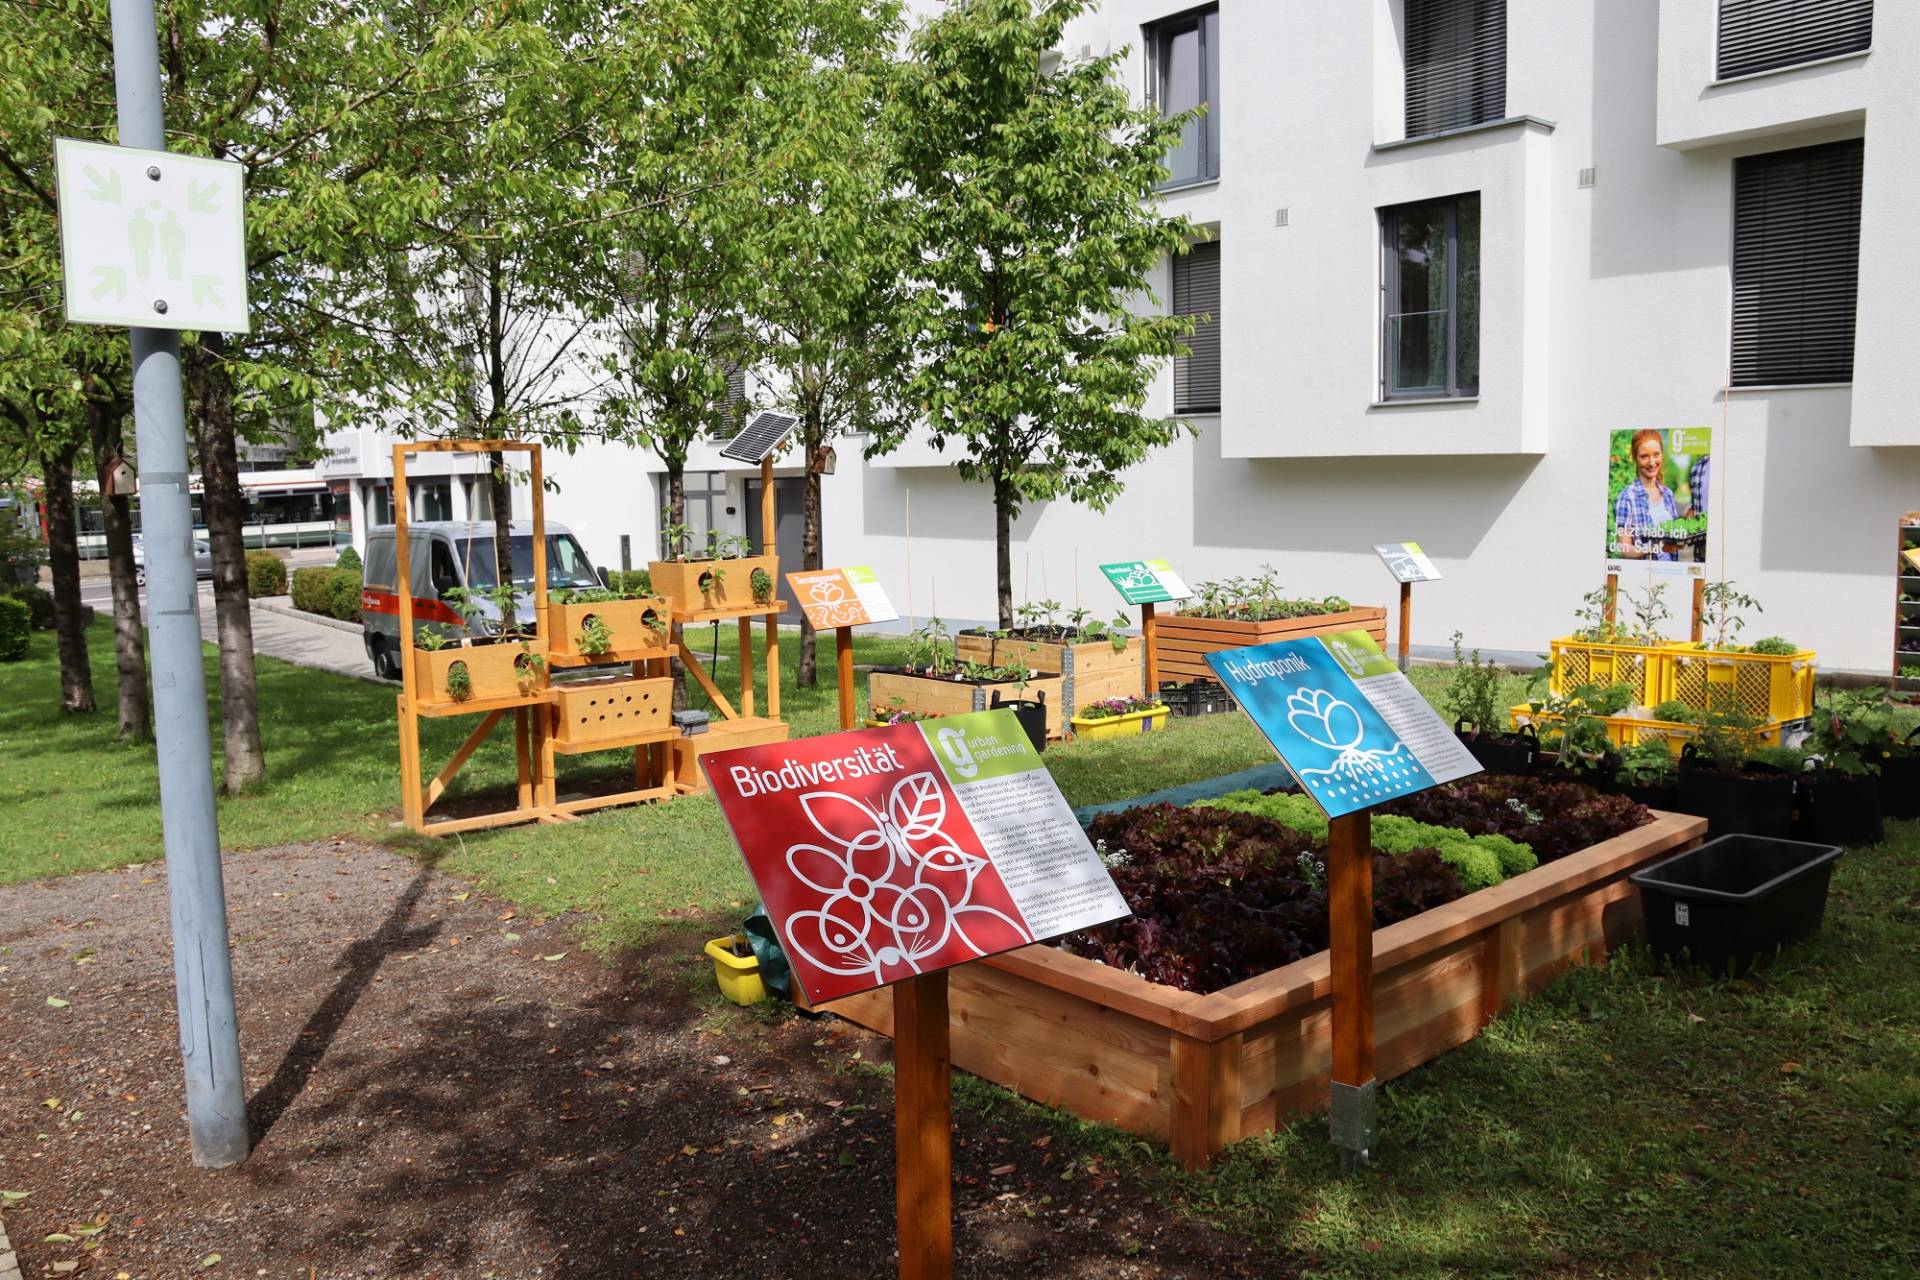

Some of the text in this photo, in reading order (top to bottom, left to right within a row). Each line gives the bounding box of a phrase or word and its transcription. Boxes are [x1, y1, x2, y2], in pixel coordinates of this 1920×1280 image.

[1610, 521, 1639, 537] Jetzt
[1669, 524, 1688, 539] ich
[1609, 539, 1664, 555] den Salat
[1223, 651, 1312, 687] Hydroponik
[967, 735, 998, 749] urban
[973, 743, 1027, 762] gardening
[729, 741, 905, 799] Biodiversität
